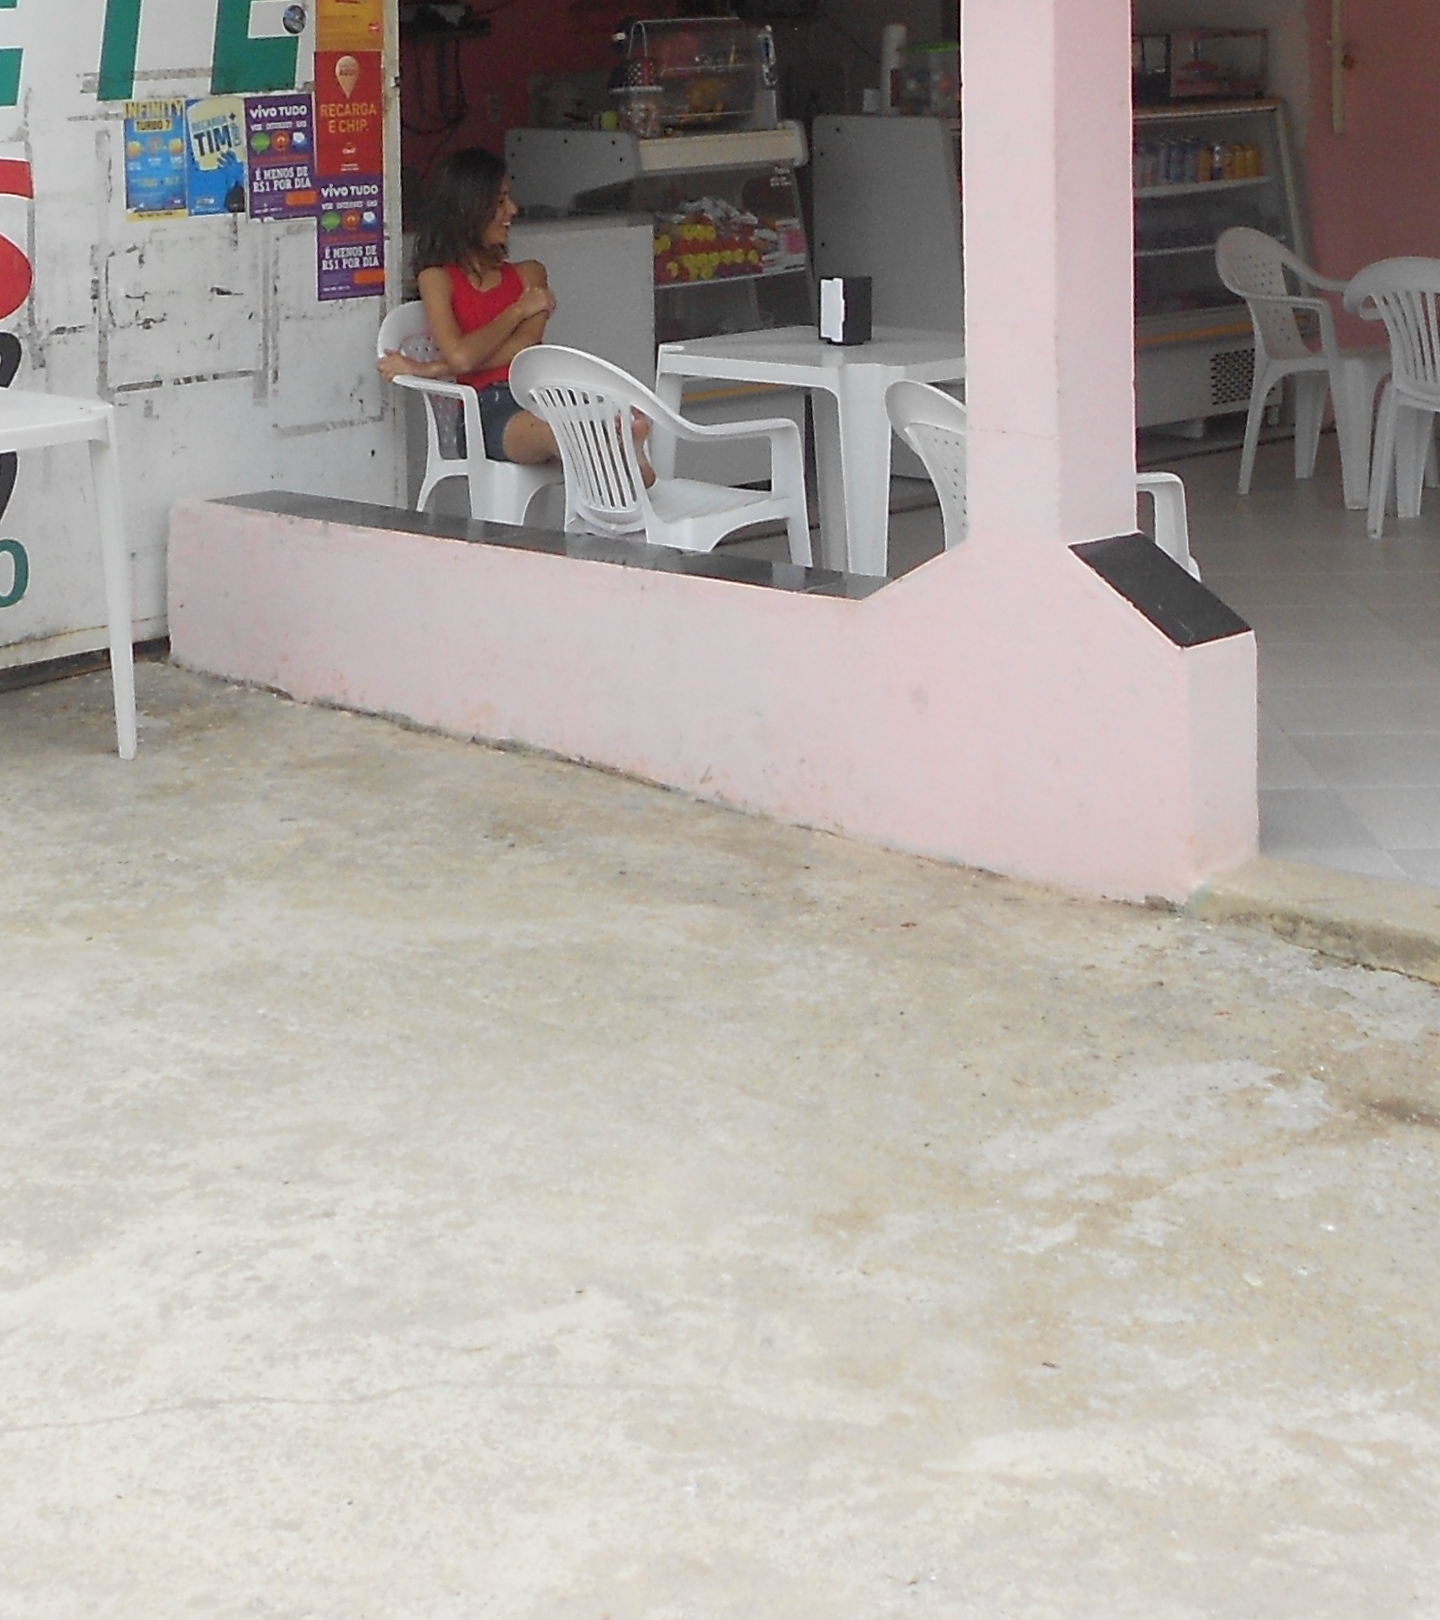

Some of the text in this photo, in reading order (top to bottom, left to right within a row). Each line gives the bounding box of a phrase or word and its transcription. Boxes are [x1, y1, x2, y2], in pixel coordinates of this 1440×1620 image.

[279, 105, 308, 117] TUDO
[320, 102, 378, 118] RECARGA
[328, 118, 336, 134] E
[193, 124, 233, 157] TIM
[255, 166, 309, 181] É MENOS DE
[273, 179, 293, 191] POR
[295, 177, 312, 189] DIA
[349, 185, 379, 196] TUDO
[324, 245, 377, 259] É MENOS DE
[342, 258, 360, 269] POR
[362, 256, 380, 267] DIA
